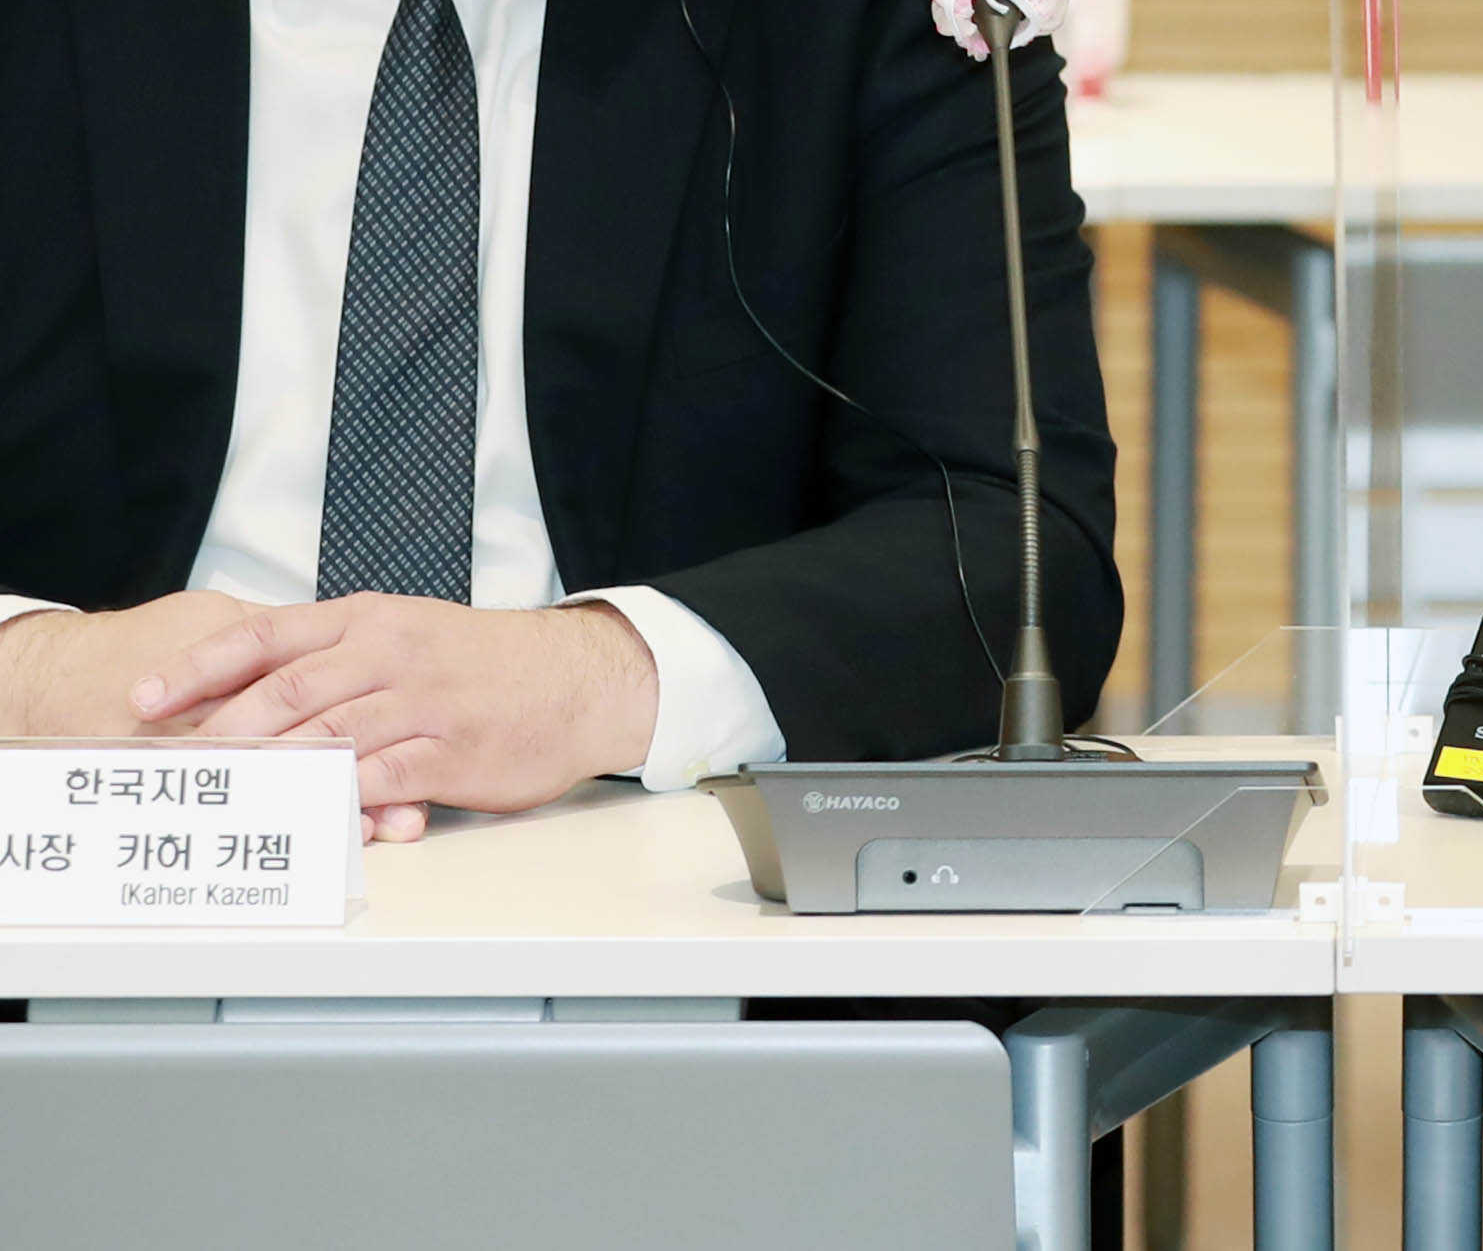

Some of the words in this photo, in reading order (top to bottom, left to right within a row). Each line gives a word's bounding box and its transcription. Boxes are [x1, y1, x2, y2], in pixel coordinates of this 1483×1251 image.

[65, 767, 231, 806] 한국지엠
[826, 795, 900, 810] HAYACO
[0, 833, 77, 873] 사장
[116, 833, 192, 871] 카허
[215, 833, 292, 871] 카젬
